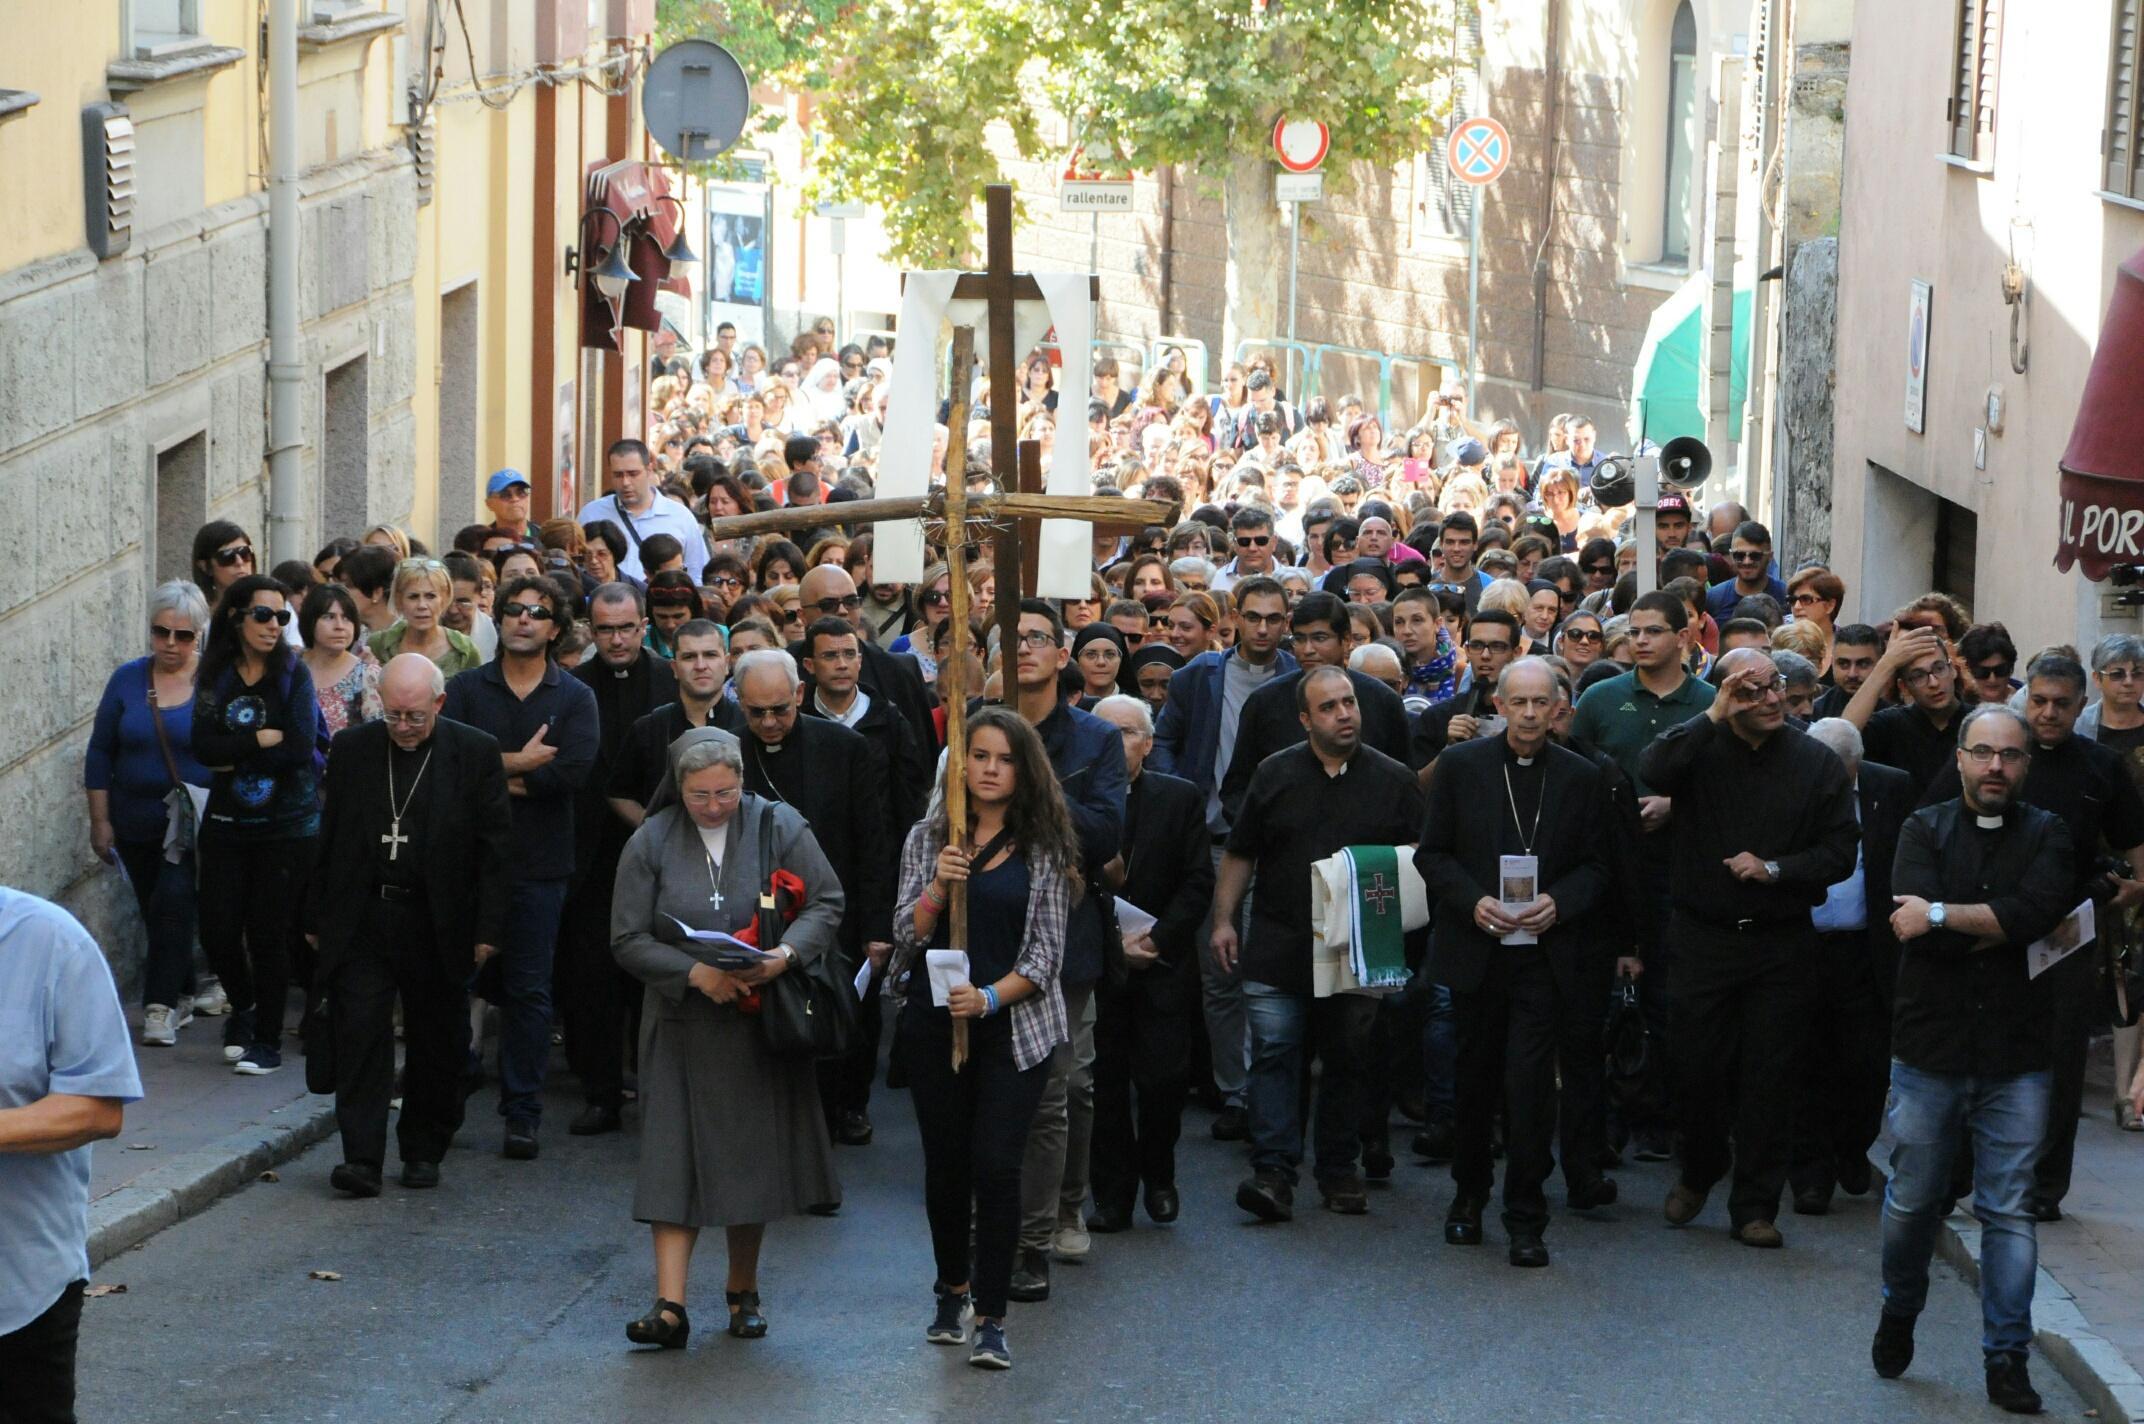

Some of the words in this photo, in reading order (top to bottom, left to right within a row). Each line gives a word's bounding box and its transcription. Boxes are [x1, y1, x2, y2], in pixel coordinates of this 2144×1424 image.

[1067, 192, 1128, 204] rallentare
[2063, 500, 2075, 545] IL
[2080, 504, 2144, 556] POR
